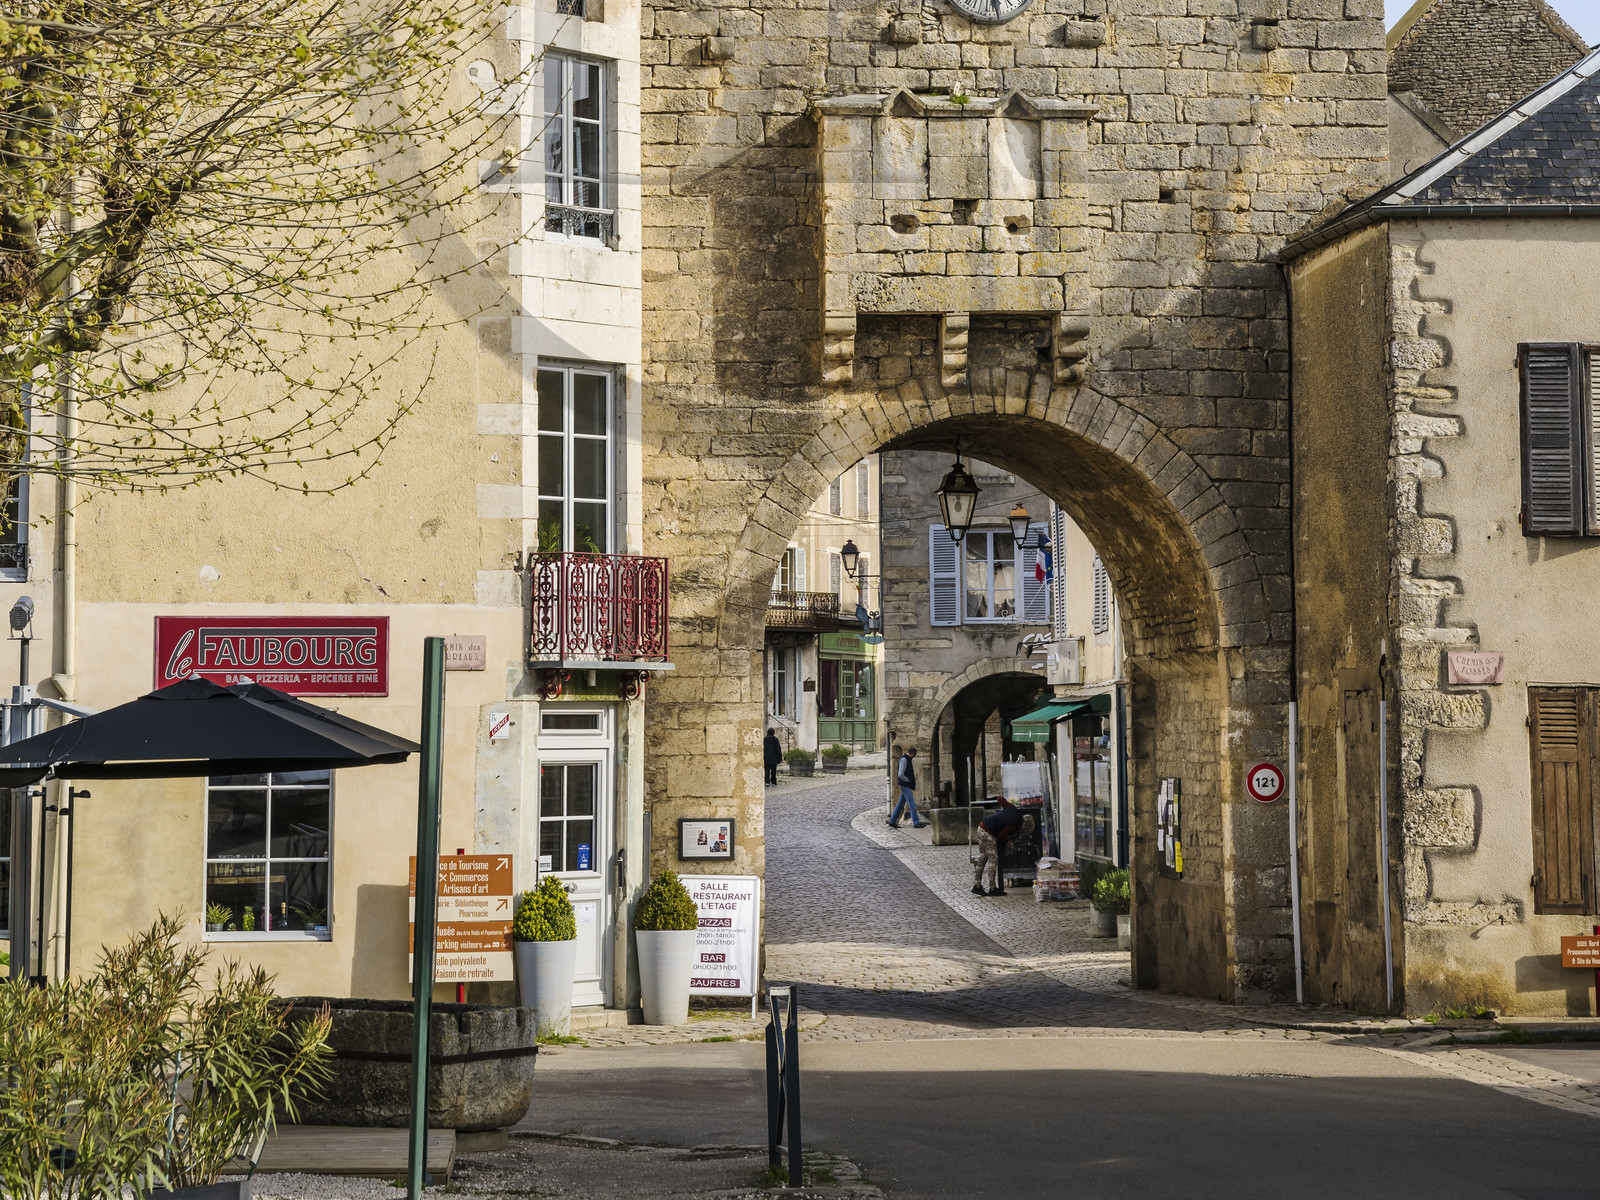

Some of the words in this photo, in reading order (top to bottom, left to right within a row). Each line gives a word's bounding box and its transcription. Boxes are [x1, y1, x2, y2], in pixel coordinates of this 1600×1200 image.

[468, 642, 481, 651] des
[164, 629, 195, 680] le
[197, 627, 378, 666] FAUBOURG
[1456, 655, 1483, 666] CHEMIN
[256, 674, 301, 684] PIZZERIA
[311, 674, 354, 683] EPICERIE
[356, 674, 379, 683] FINE
[449, 860, 458, 870] de
[458, 860, 489, 870] Tourisme
[449, 871, 489, 882] Commerces
[443, 884, 472, 894] Artisans
[472, 883, 489, 894] d'art
[700, 882, 729, 891] SALLE
[693, 892, 752, 901] RESTAURANT
[455, 899, 489, 909] Bibliothèque
[701, 902, 737, 910] L'ETAGE
[459, 909, 489, 918] Pharmacie
[698, 918, 731, 927] PIZZAS
[437, 940, 459, 951] arking
[460, 941, 483, 949] visiteurs
[436, 956, 449, 966] alle
[450, 955, 487, 968] polyvalente
[702, 954, 724, 962] BAR
[458, 968, 467, 978] de
[468, 967, 494, 978] retraite
